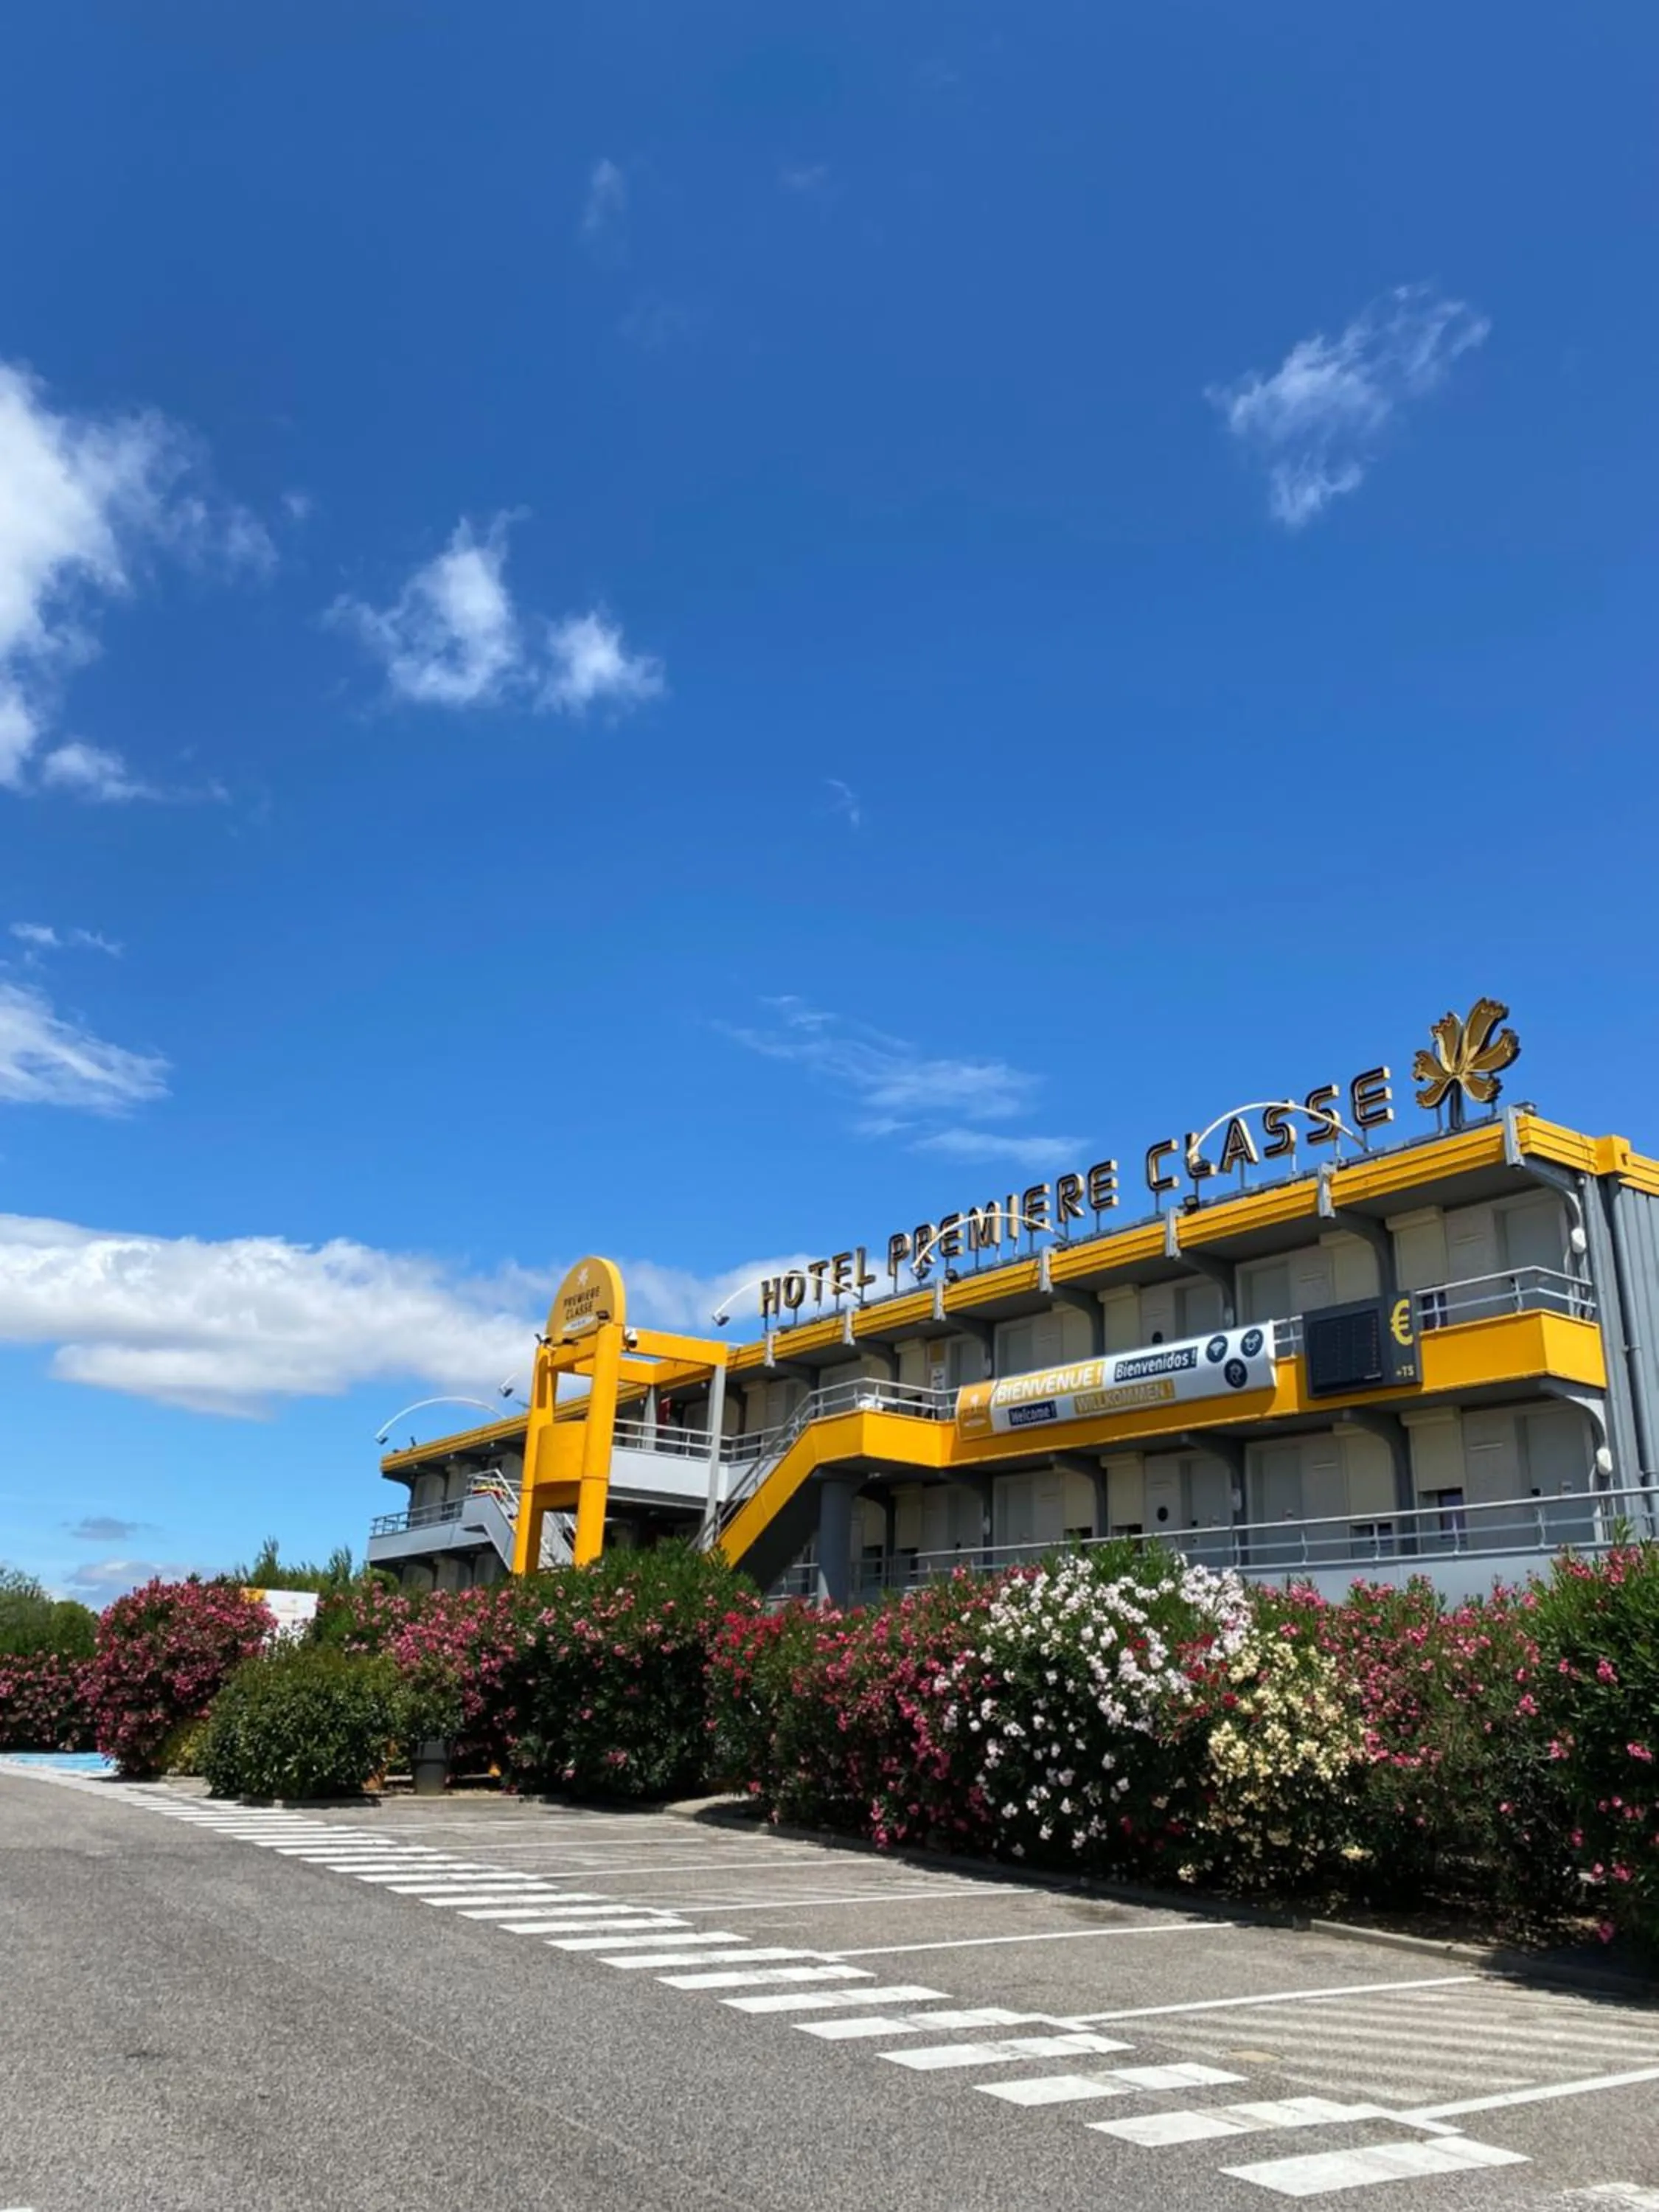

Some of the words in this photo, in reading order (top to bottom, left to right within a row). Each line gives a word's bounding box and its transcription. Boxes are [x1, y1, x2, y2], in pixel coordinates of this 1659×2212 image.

[759, 1246, 876, 1317] HOTEL
[888, 1159, 1119, 1276] PREMIERE
[1146, 1065, 1394, 1192] CLASSE
